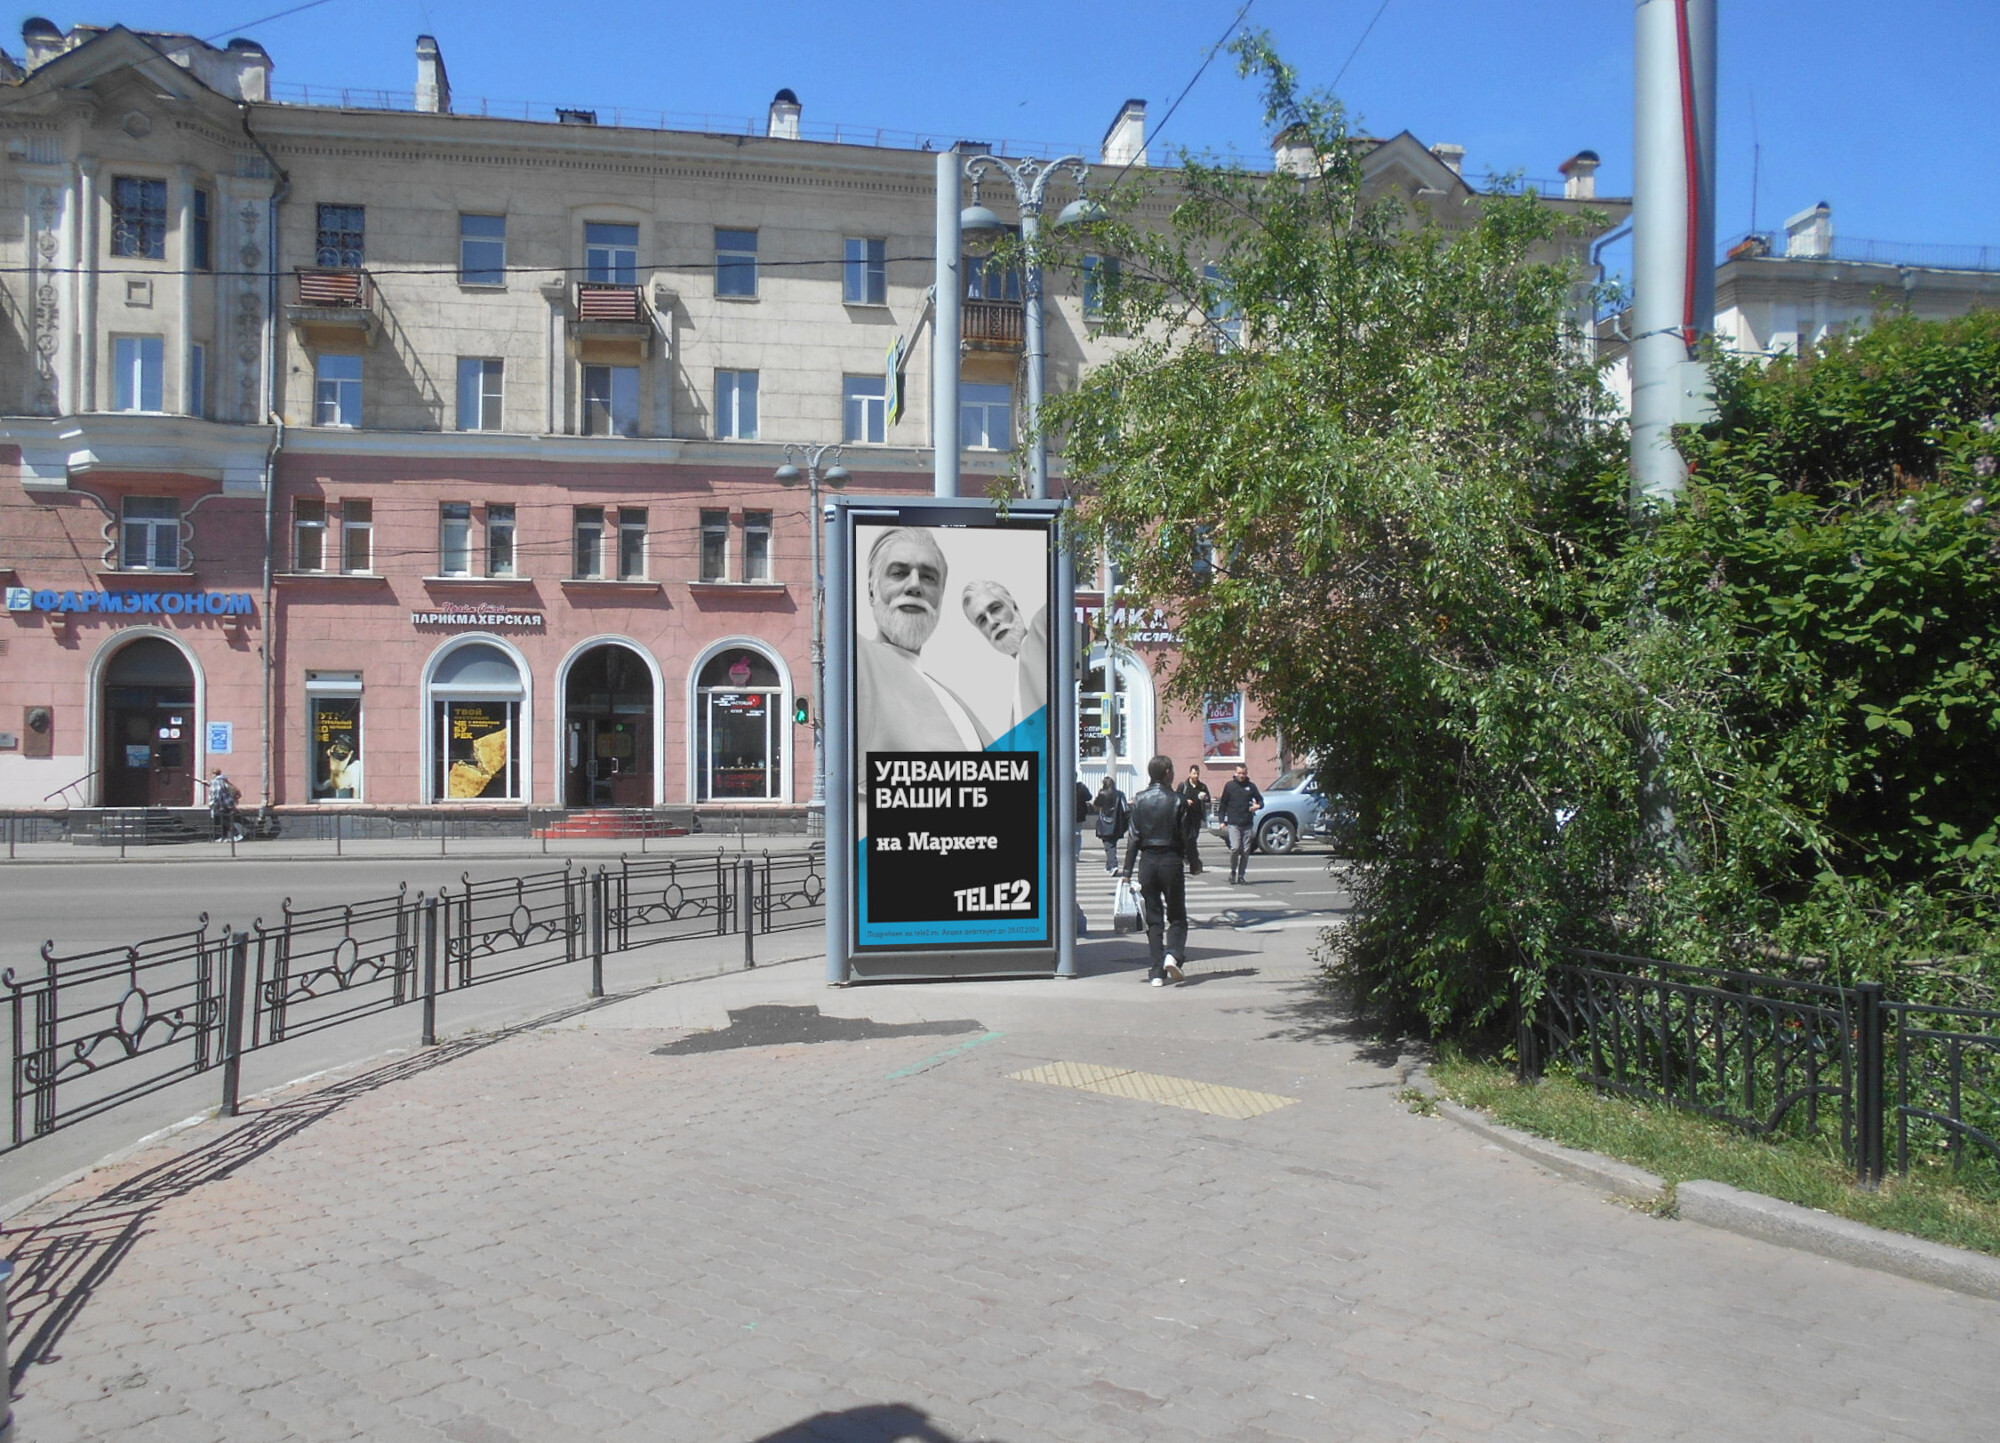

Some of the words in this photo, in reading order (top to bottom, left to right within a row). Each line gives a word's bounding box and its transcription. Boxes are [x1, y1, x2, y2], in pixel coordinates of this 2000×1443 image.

[33, 589, 253, 615] ФАРМЭКОНОМ
[411, 613, 542, 625] ПАРИКМАХЕРСКАЯ
[874, 760, 1029, 786] УДВАИВАЕМ
[875, 787, 951, 808] ВАШИ
[958, 787, 988, 808] ГБ
[876, 837, 902, 851] на
[907, 832, 998, 855] Маркете
[953, 879, 1032, 912] TELE2
